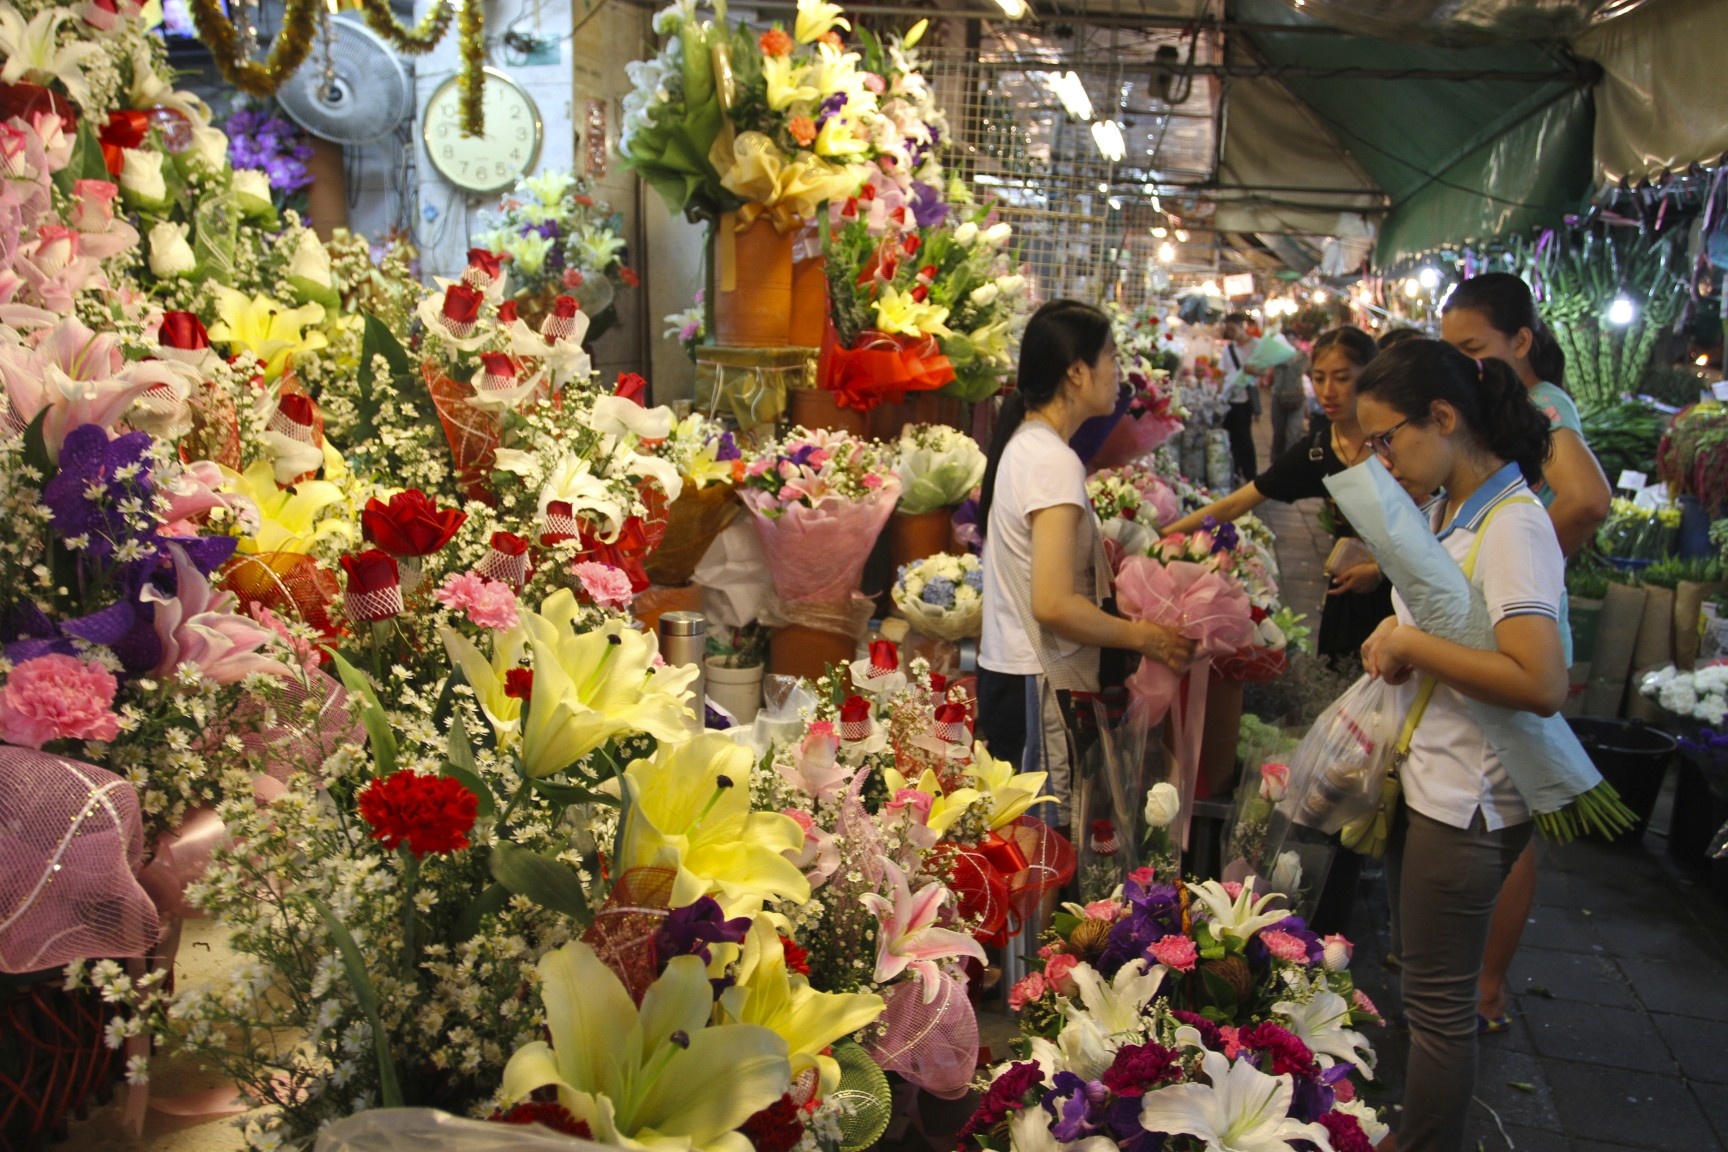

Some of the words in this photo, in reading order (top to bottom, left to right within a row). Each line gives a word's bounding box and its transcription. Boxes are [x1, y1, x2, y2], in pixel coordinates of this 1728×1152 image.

[440, 103, 456, 118] 10
[510, 105, 521, 119] 2
[437, 126, 448, 139] 9
[516, 127, 526, 141] 3
[443, 145, 454, 159] 8
[509, 147, 520, 160] 4
[460, 160, 469, 174] 7
[475, 167, 487, 181] 6
[495, 162, 506, 176] 5
